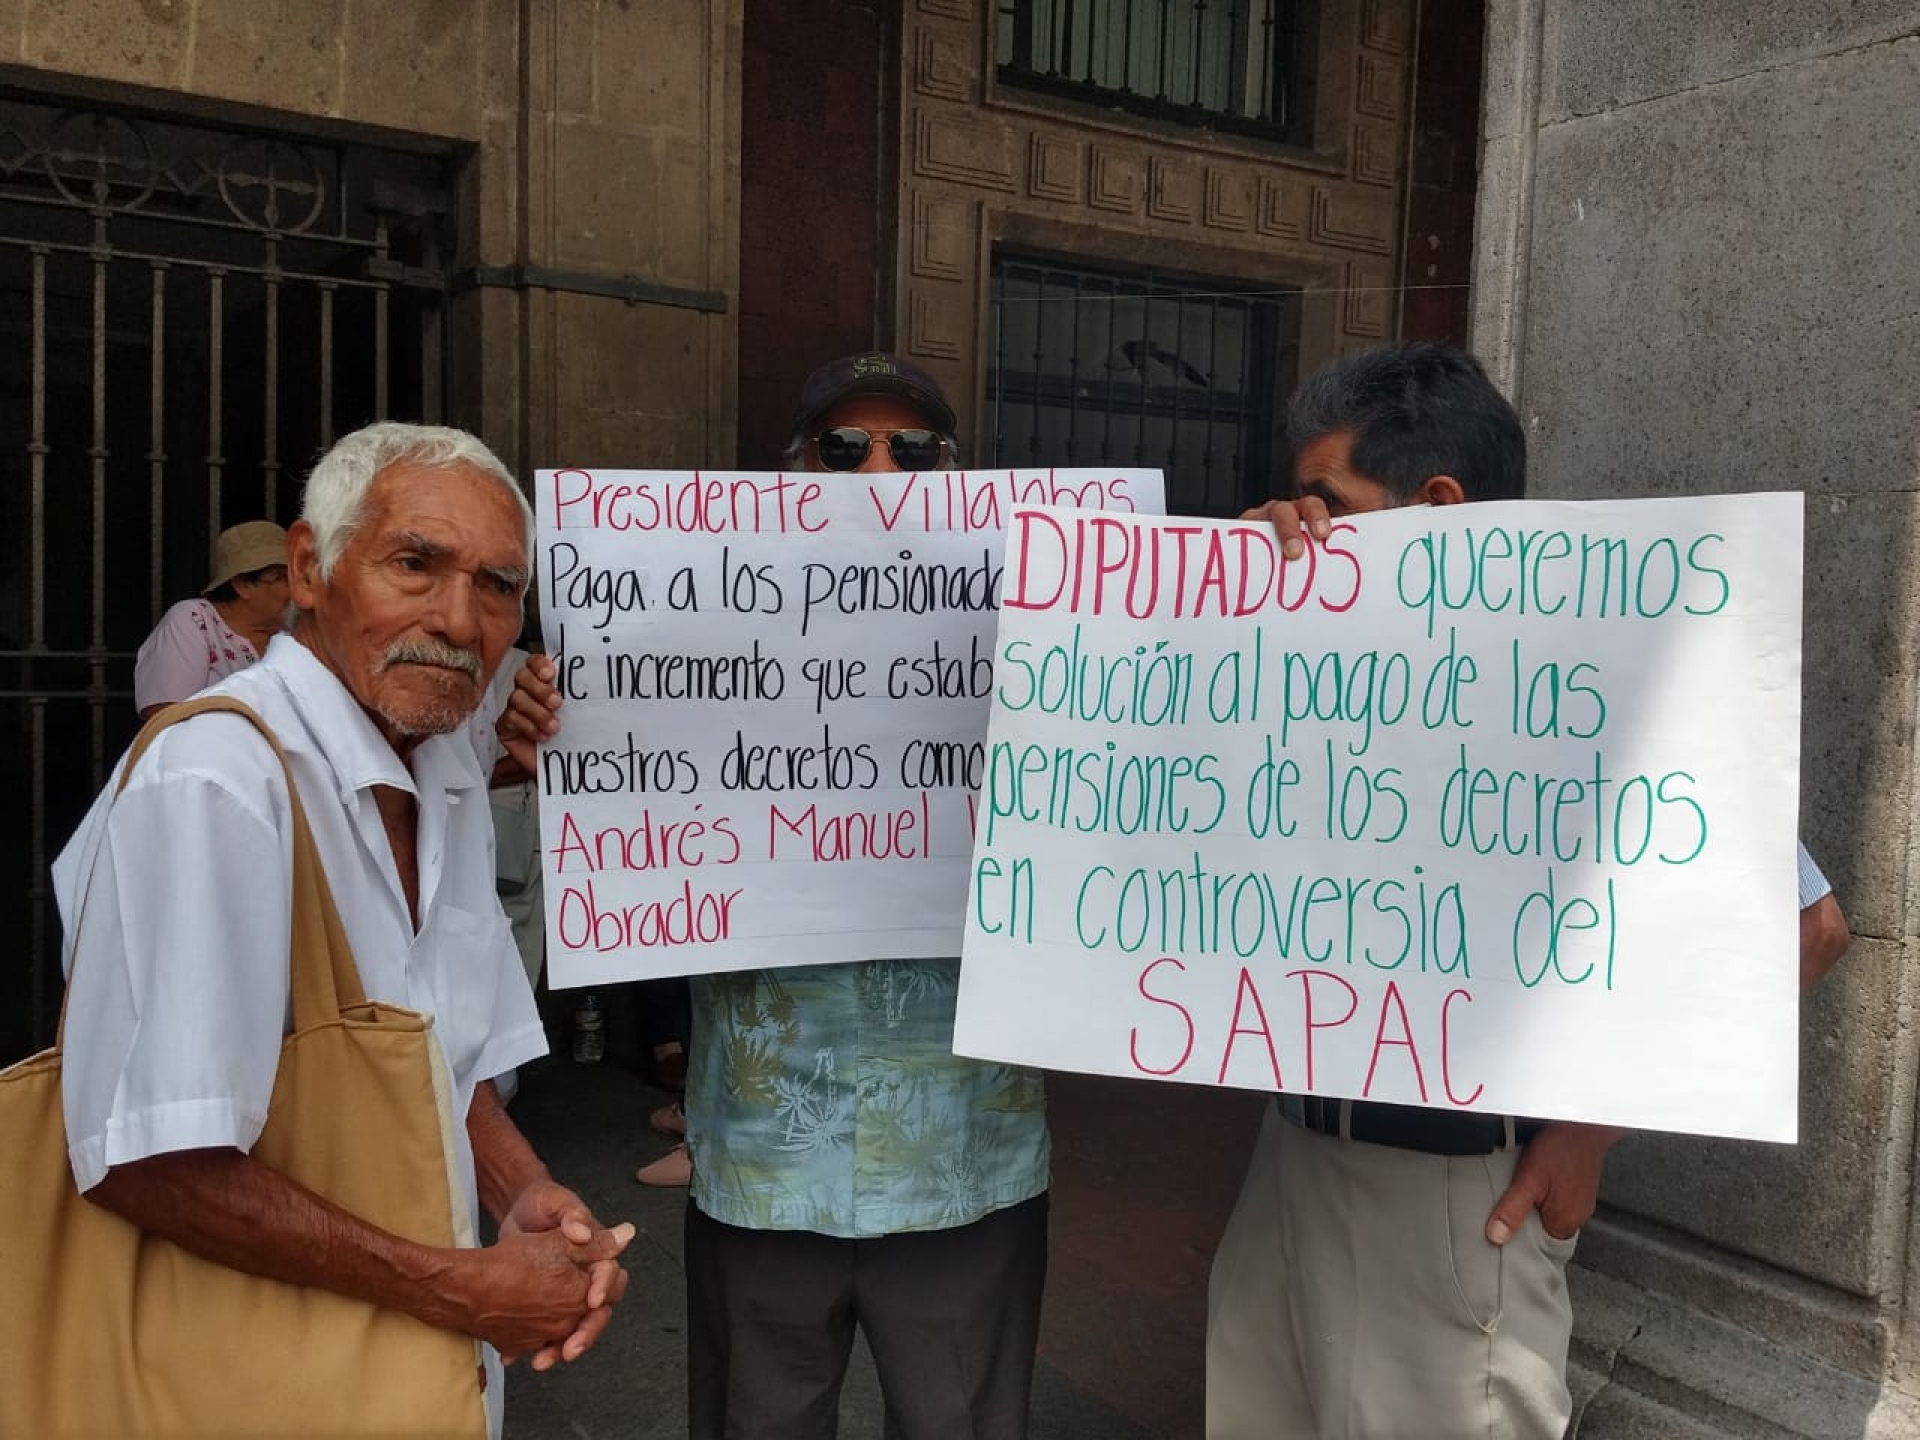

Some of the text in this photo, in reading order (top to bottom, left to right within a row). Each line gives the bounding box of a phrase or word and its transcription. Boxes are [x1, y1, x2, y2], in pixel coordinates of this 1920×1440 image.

[553, 470, 829, 534] Presidente
[668, 568, 698, 613] a
[722, 546, 783, 614] los
[1002, 511, 1731, 640] DIPUTADOS queremos
[551, 623, 588, 700] de
[605, 635, 784, 700] incremento
[802, 658, 866, 715] que
[998, 623, 1607, 757] solución al pago de las
[542, 724, 985, 796] nuestros decretos como
[985, 740, 1228, 847] pensiones
[1246, 734, 1299, 840] de
[1325, 738, 1408, 844] los
[1439, 743, 1709, 866] decretos
[550, 804, 740, 873] Andrés
[770, 792, 929, 861] Manuel
[559, 880, 744, 951] Obrador
[975, 851, 1617, 992] en controversia del
[1130, 958, 1485, 1106] SAPAC
